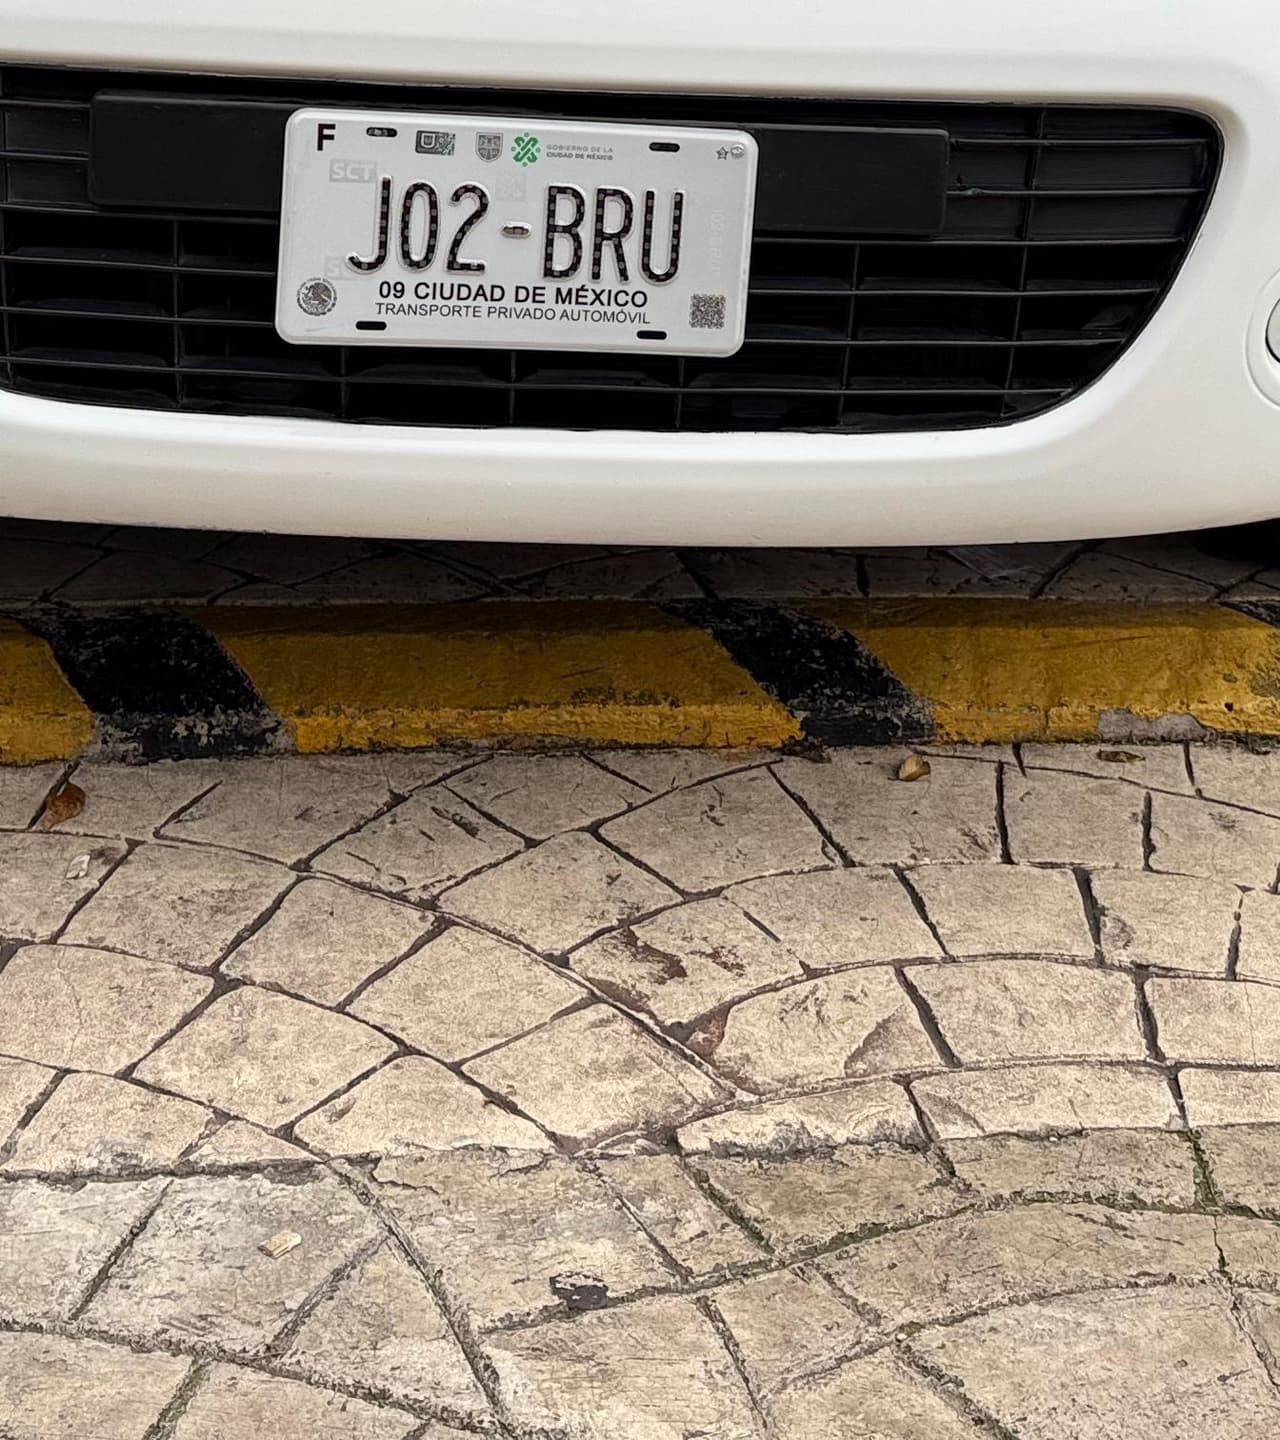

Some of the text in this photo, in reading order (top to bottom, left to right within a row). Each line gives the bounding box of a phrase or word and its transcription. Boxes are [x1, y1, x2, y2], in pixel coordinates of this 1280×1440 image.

[317, 124, 336, 151] F
[546, 143, 589, 152] GOBIERNO
[546, 151, 573, 159] CIUDAD
[346, 175, 685, 283] J02-BRU
[378, 280, 648, 308] 09 CIUDAD DE MÉXICO
[375, 302, 651, 325] TRANSPORTE PRIVADO AUTOMÓVIL
